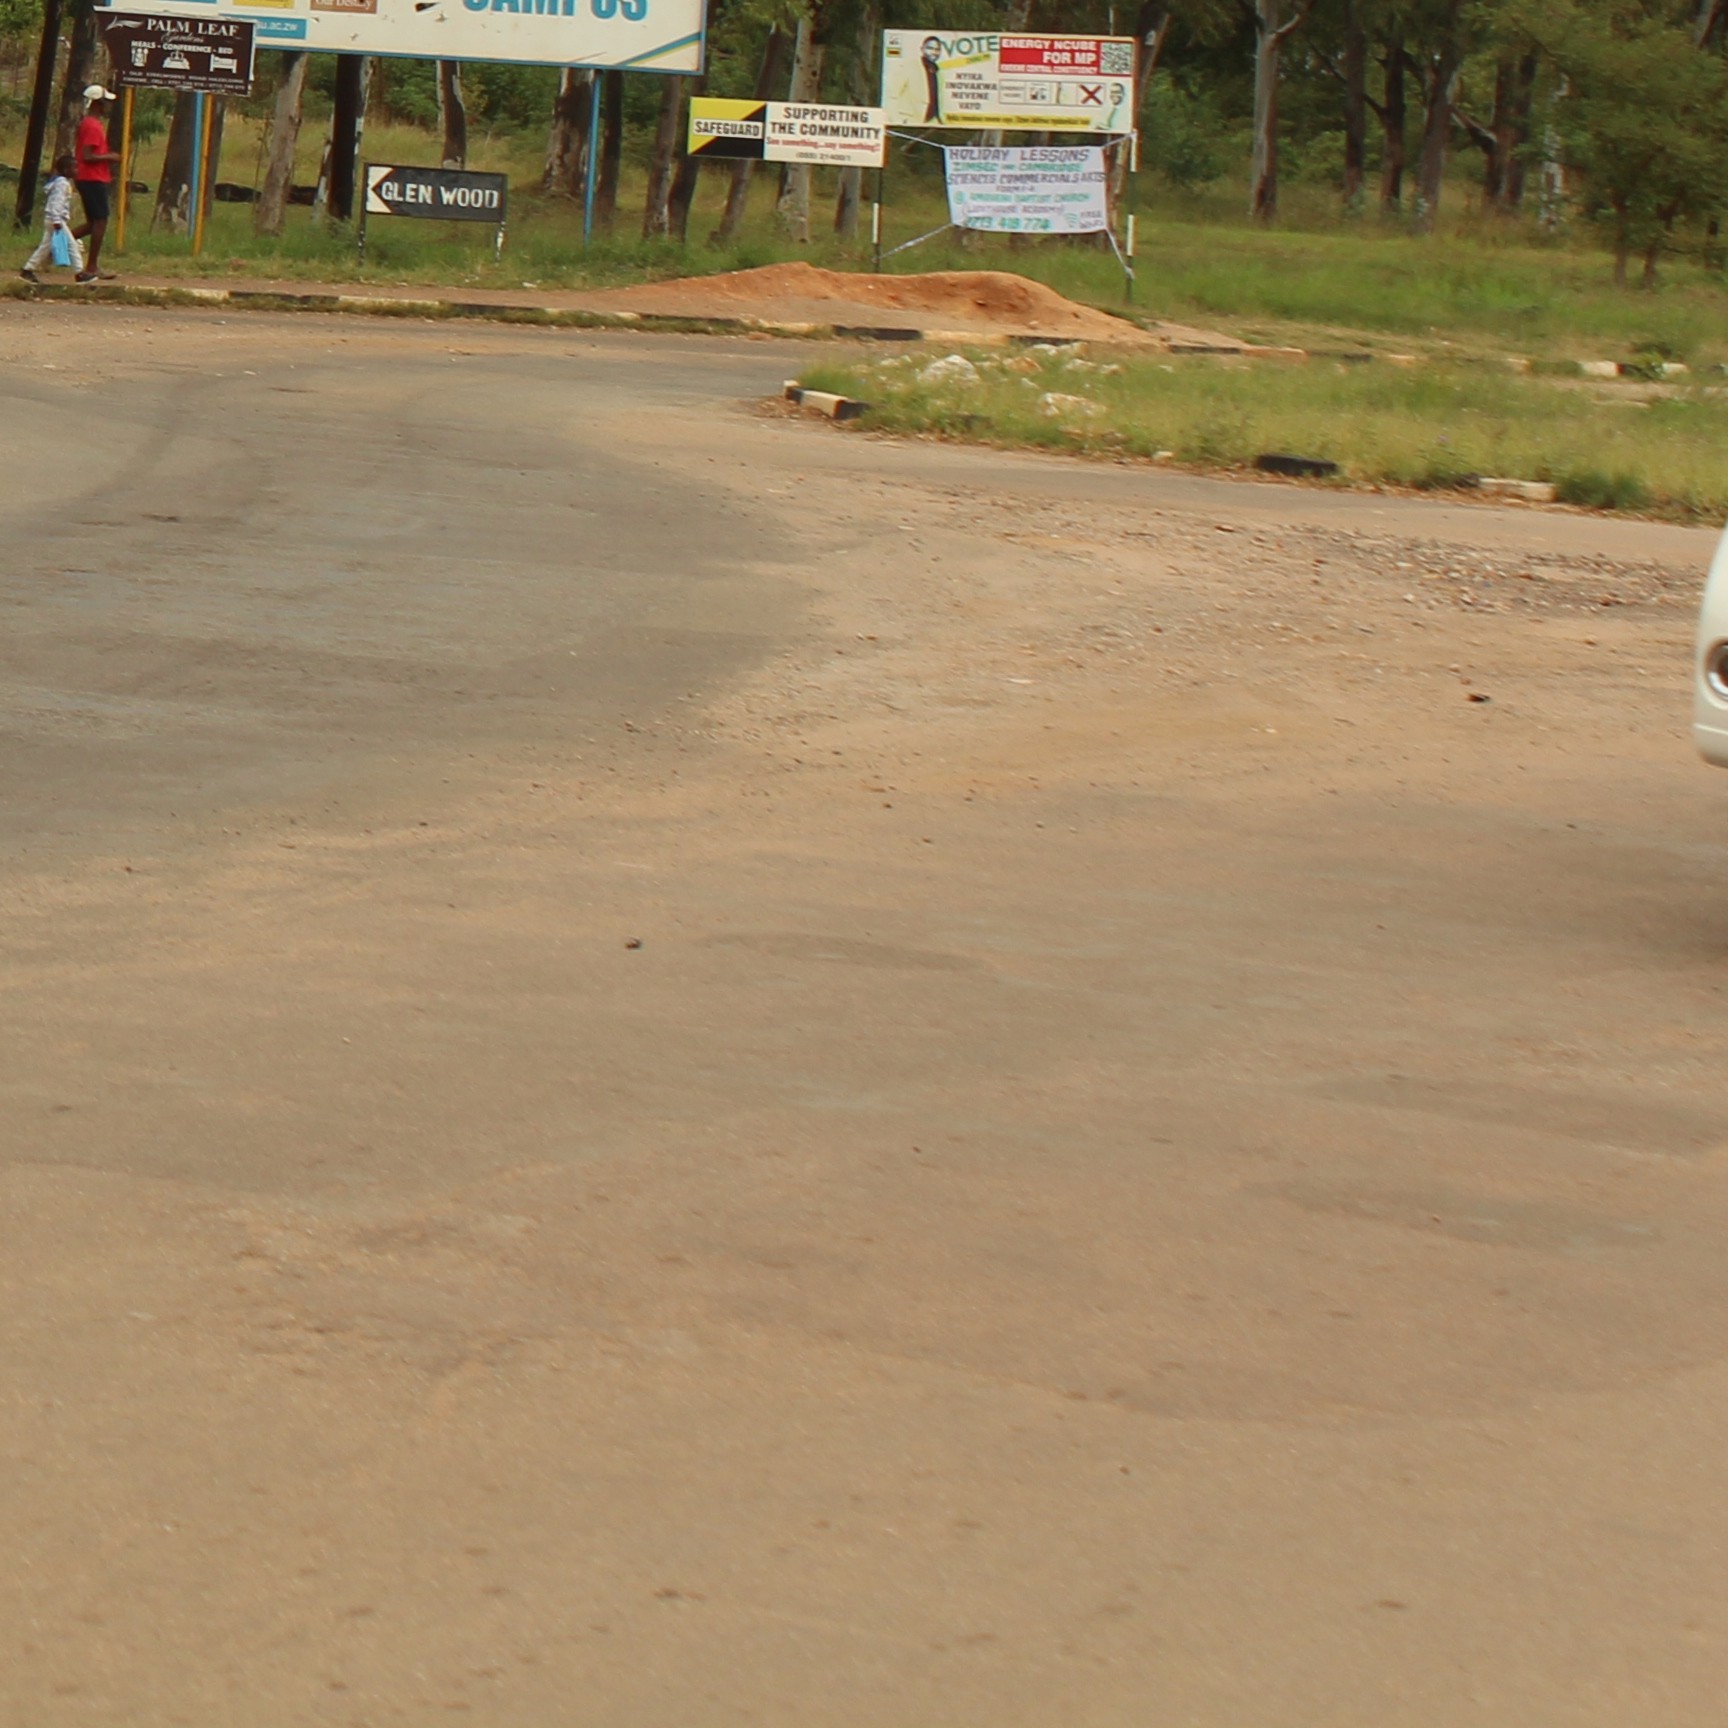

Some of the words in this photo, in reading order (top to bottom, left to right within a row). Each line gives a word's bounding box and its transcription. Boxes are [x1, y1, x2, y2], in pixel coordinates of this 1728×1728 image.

[147, 18, 190, 33] PALM
[197, 22, 239, 37] LEAF
[131, 40, 156, 49] MEALS
[162, 43, 212, 53] CONFERENCE
[940, 35, 1000, 57] VOTE
[1001, 38, 1052, 50] ENERGY
[1054, 40, 1097, 51] NCUBE
[1042, 51, 1072, 63] FOR
[1075, 52, 1097, 64] MP
[783, 106, 869, 123] SUPPORTING
[694, 120, 760, 137] SAFEGUARD
[770, 121, 795, 135] THE
[800, 123, 881, 139] COMMUNITY
[949, 148, 1009, 161] HOLIDAY
[1020, 148, 1090, 162] LESSONS
[381, 181, 432, 205] GLEN
[440, 186, 499, 209] WOOD
